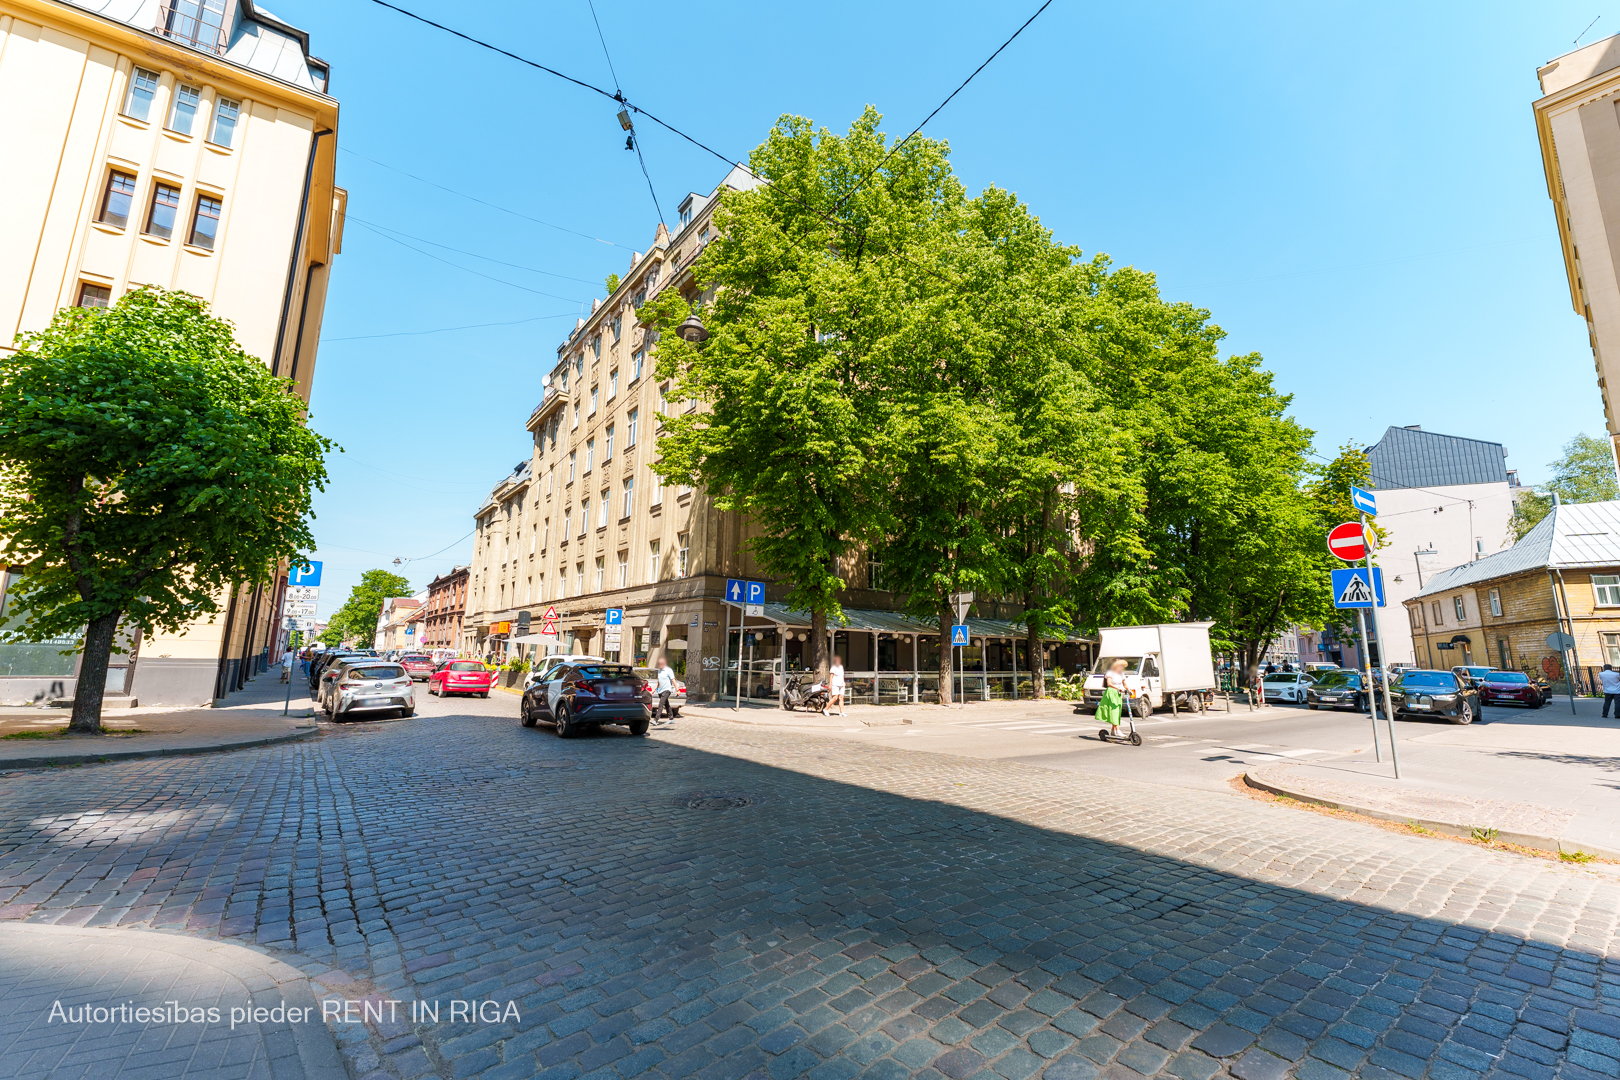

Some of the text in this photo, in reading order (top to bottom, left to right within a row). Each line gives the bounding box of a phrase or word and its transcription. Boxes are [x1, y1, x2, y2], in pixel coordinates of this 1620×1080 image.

[295, 563, 316, 583] P
[750, 584, 761, 601] P
[609, 610, 619, 623] P
